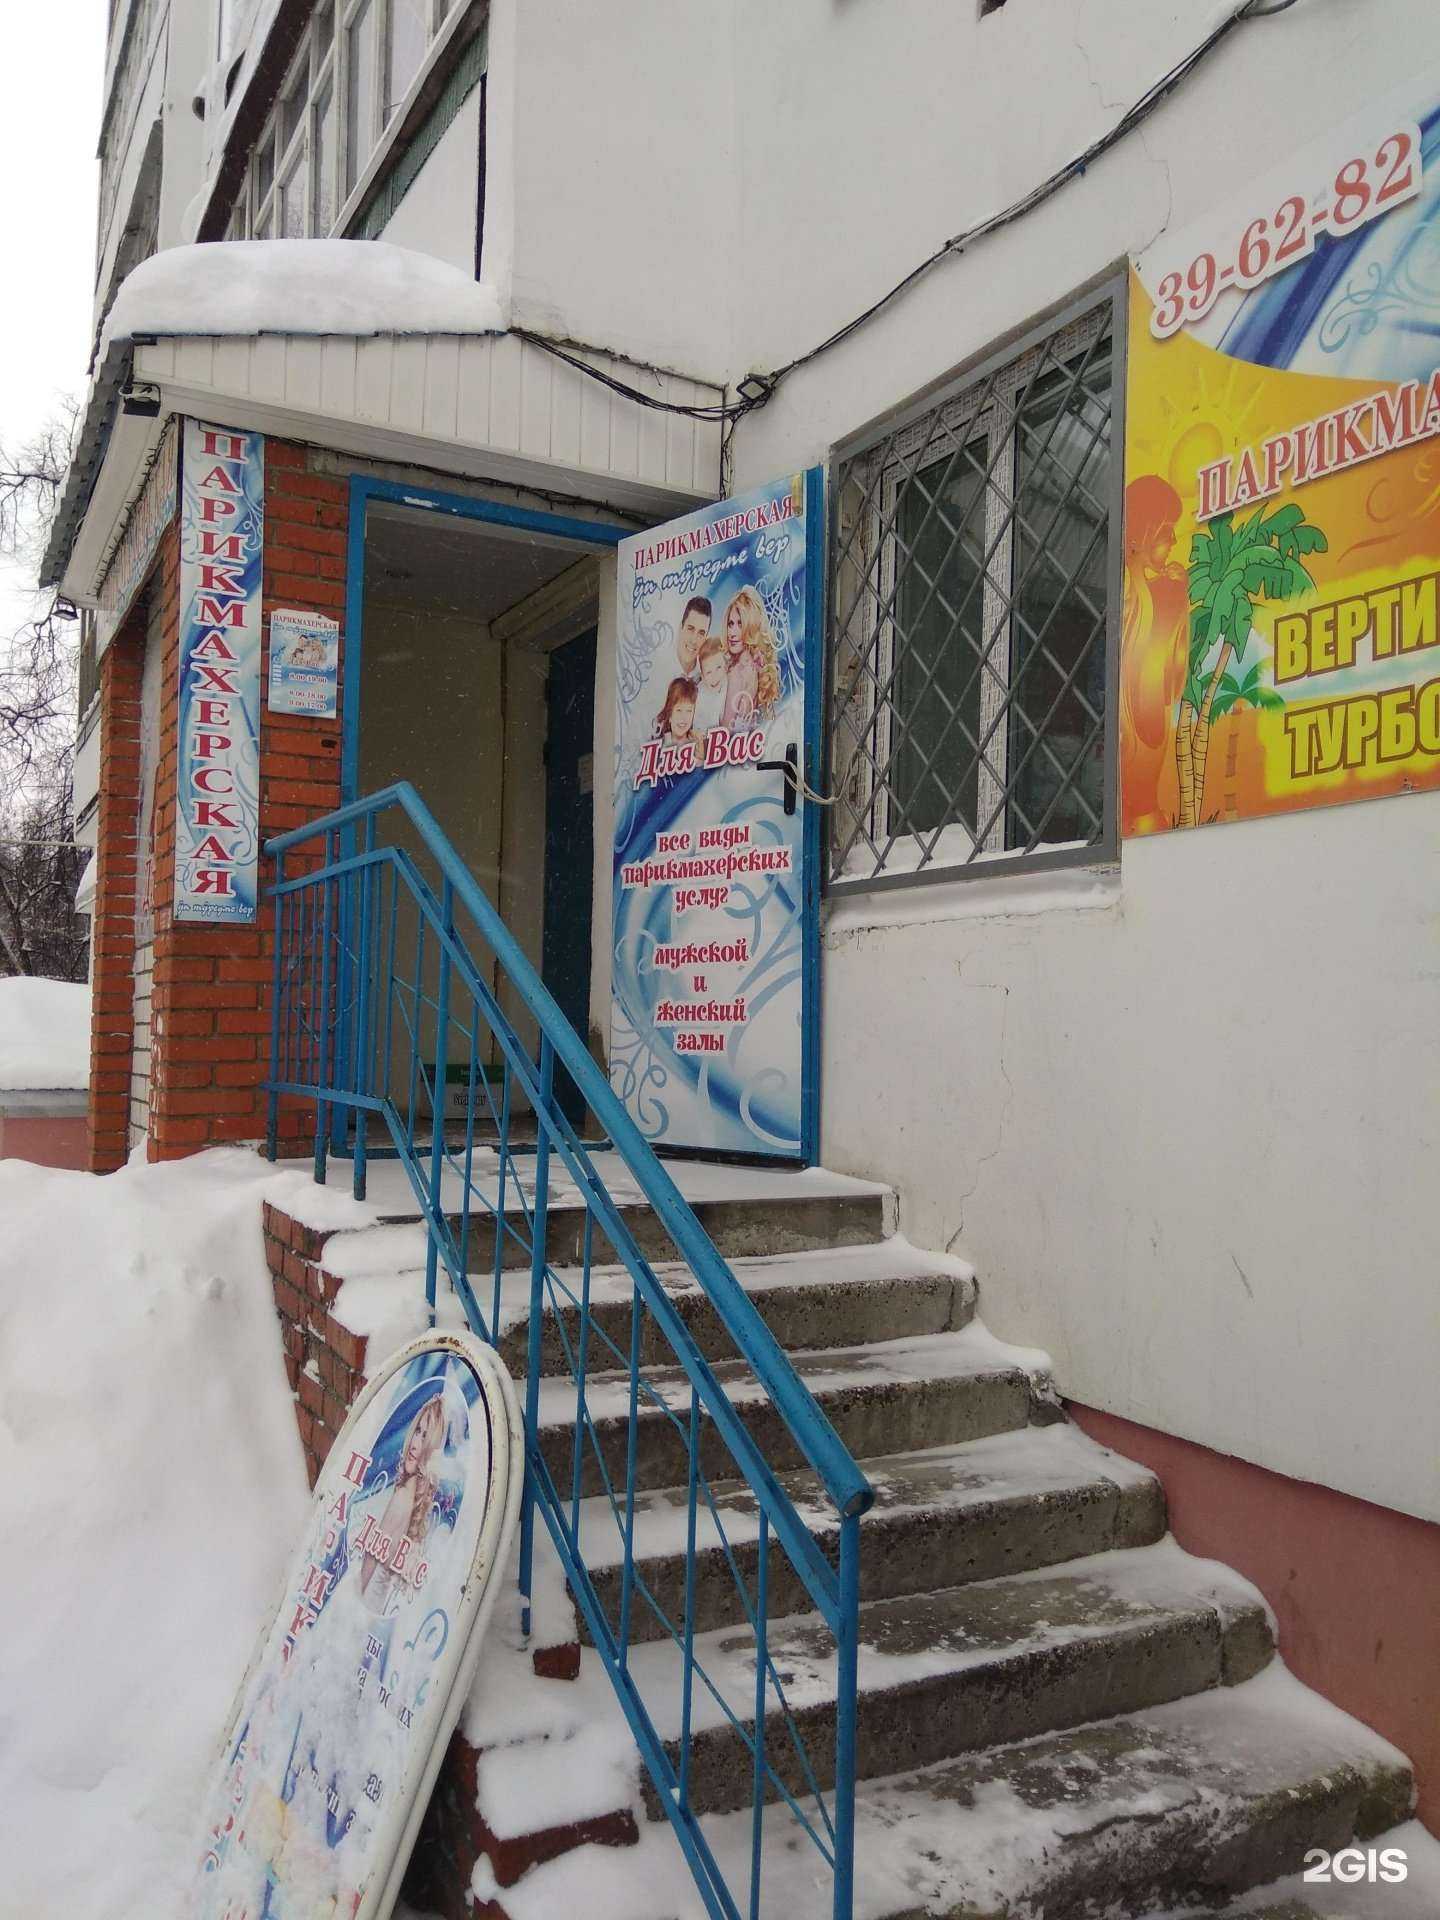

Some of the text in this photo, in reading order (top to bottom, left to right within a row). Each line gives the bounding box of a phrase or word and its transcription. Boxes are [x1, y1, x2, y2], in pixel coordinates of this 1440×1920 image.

[1156, 132, 1414, 329] 39-62-82
[634, 494, 794, 570] ПАРИКМАХЕРСКАЯ
[1274, 572, 1440, 685] ВЕРТИ
[191, 430, 248, 895] ПАРИКМАХЕРСКАЯ
[633, 736, 695, 790] Для
[705, 726, 766, 768] Вас
[658, 824, 749, 853] все виды
[623, 850, 790, 888] парикмахерских
[675, 886, 729, 912] услуг
[654, 938, 750, 968] мужской
[692, 975, 708, 993] и
[656, 998, 747, 1023] женский
[676, 1031, 725, 1052] залы
[353, 1513, 428, 1587] Для Вс
